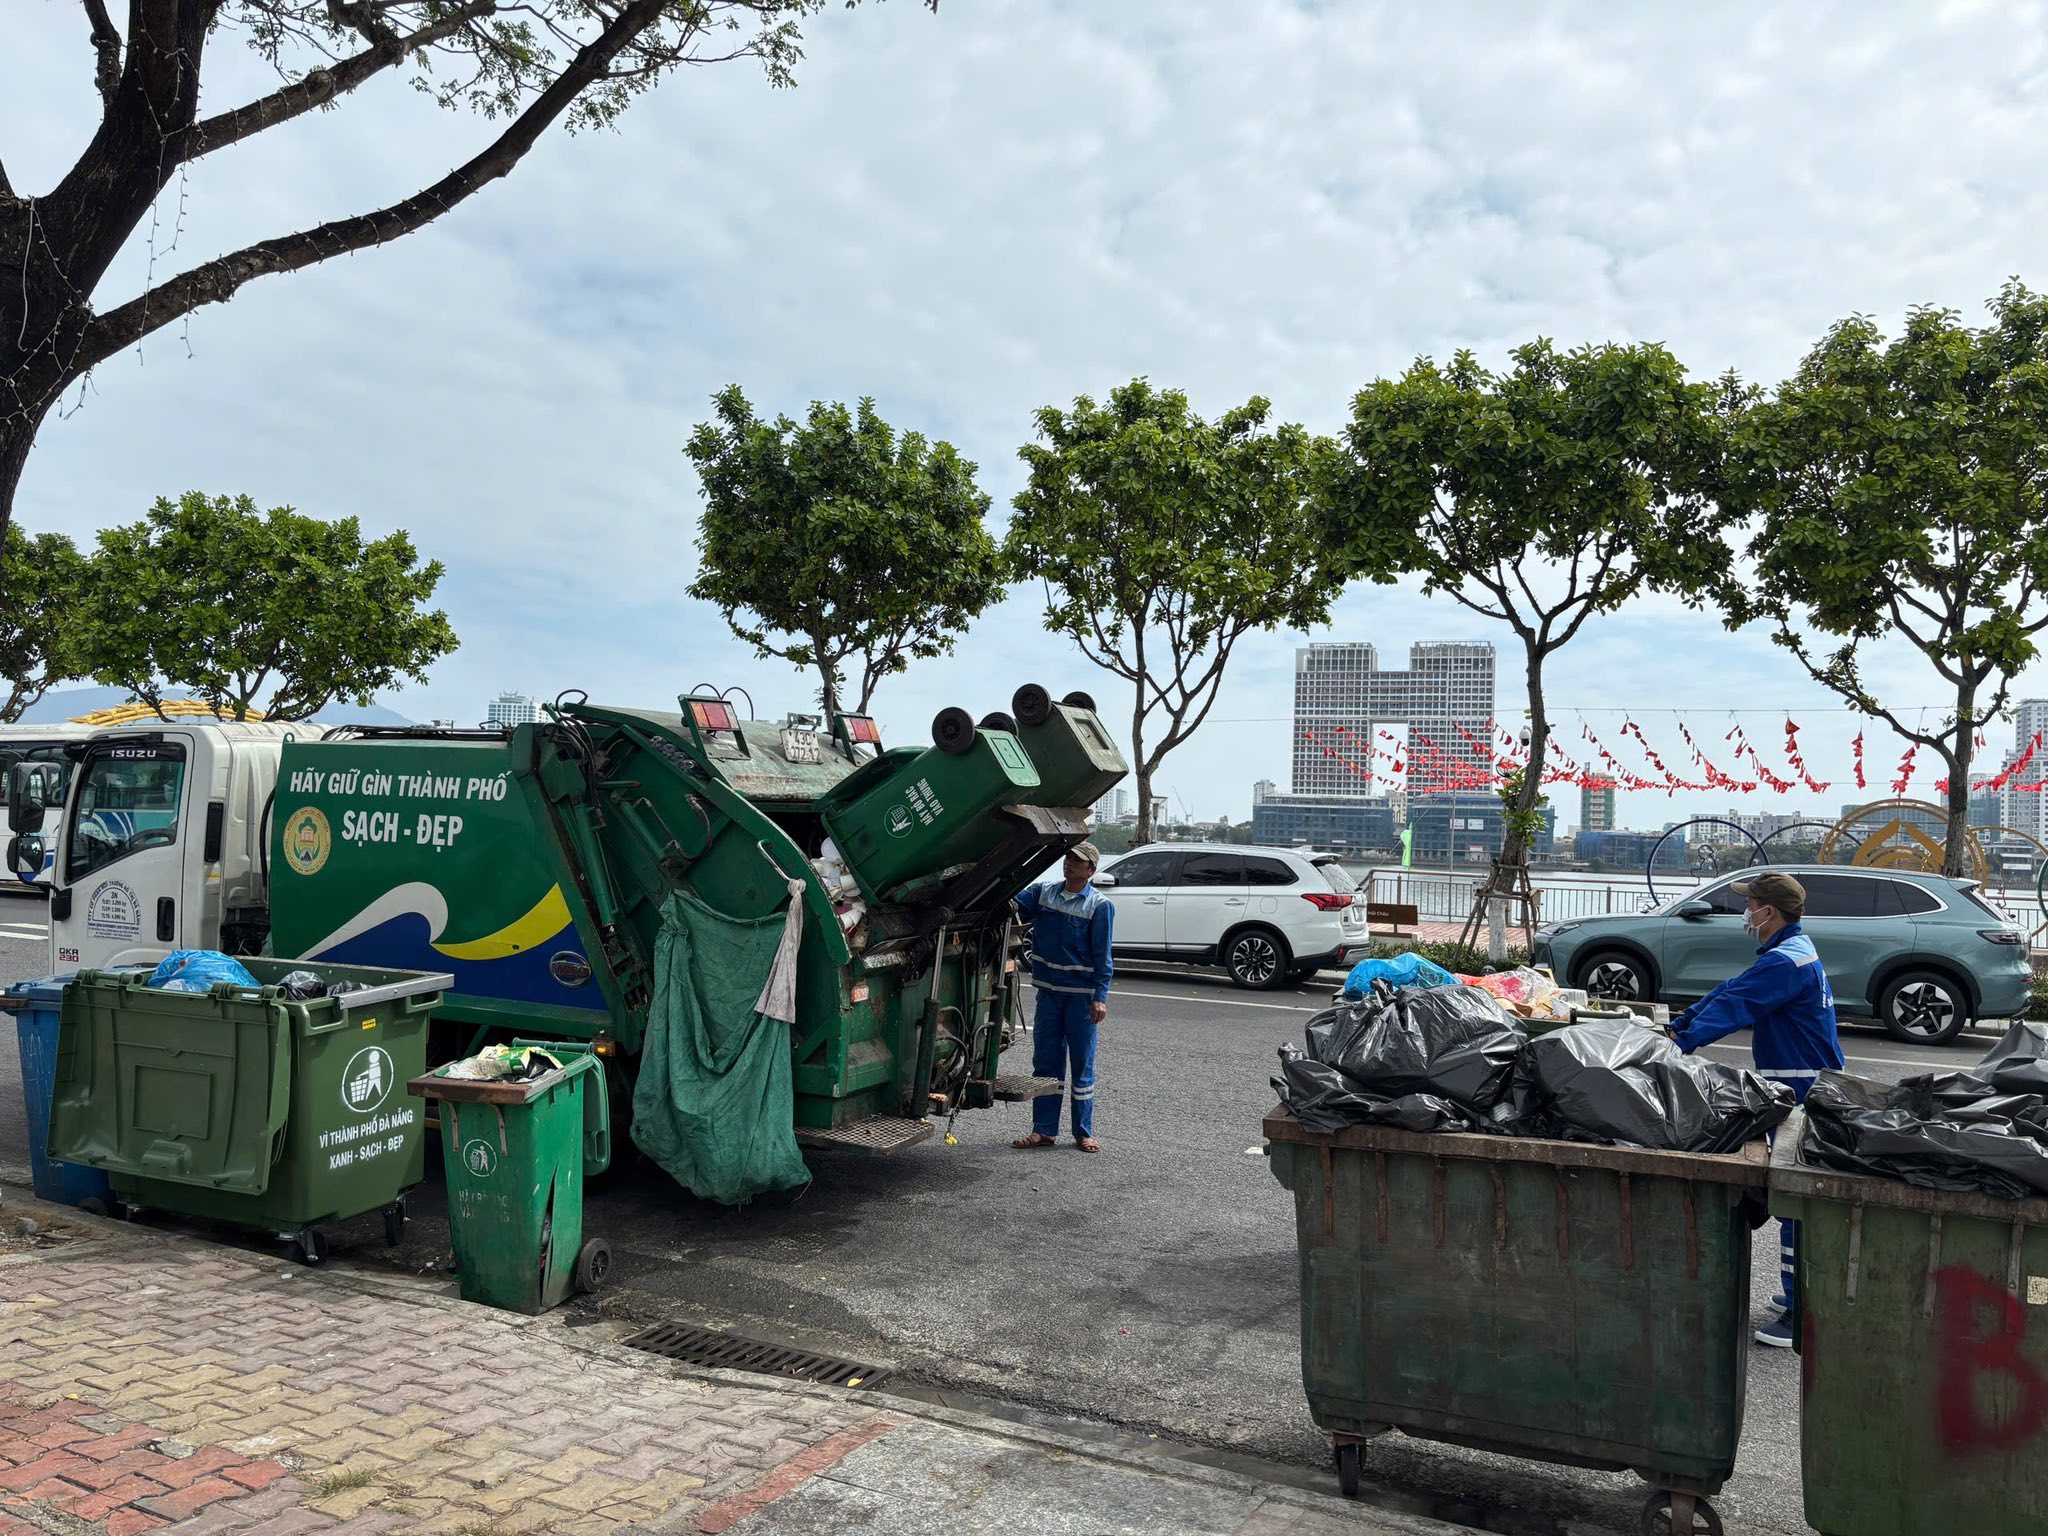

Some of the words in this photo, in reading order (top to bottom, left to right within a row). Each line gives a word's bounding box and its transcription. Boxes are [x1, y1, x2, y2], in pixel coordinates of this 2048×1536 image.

[111, 750, 156, 758] ISUZU
[795, 732, 811, 745] 43C
[290, 767, 326, 793] HÃY
[328, 768, 360, 795] GIỮ
[362, 769, 392, 796] GÌN
[398, 771, 461, 799] THÀNH
[466, 770, 512, 801] PHỐ
[341, 810, 399, 847] SẠCH
[416, 814, 463, 852] ĐẸP
[319, 1130, 329, 1149] VÌ
[330, 1122, 359, 1146] THÀNH
[360, 1113, 378, 1136] PHỐ
[379, 1113, 390, 1130] ĐÀ
[392, 1107, 413, 1129] NẴNG
[329, 1150, 353, 1170] XANH
[360, 1140, 382, 1161] SẠCH
[388, 1134, 404, 1153] ĐẸP
